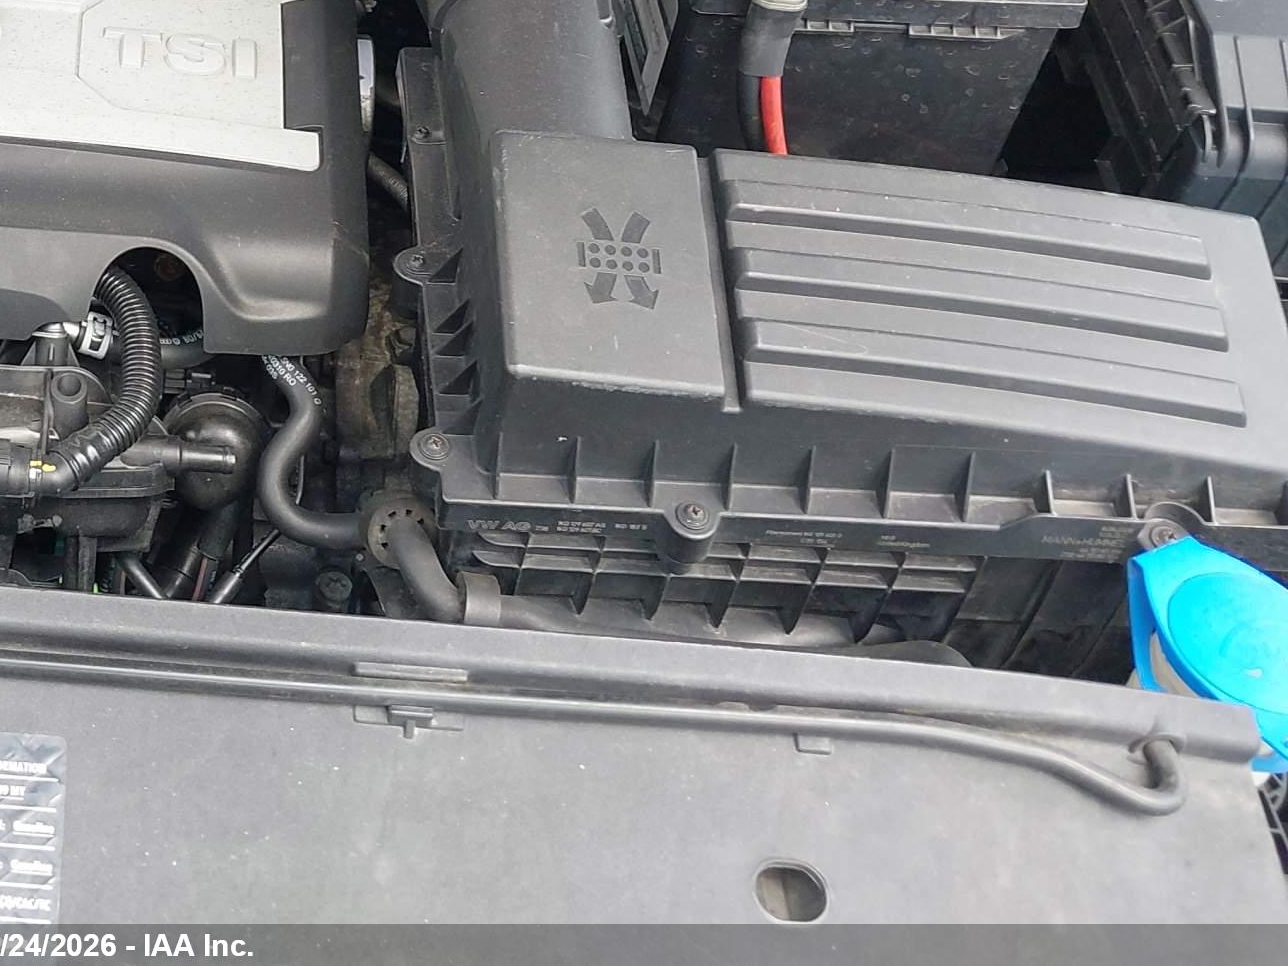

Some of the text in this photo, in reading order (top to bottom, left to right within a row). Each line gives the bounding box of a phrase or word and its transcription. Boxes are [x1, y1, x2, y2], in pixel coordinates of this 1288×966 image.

[103, 27, 258, 80] TSI
[295, 371, 307, 383] 122
[306, 383, 317, 395] 101
[467, 520, 500, 531] VW
[502, 521, 532, 532] AG
